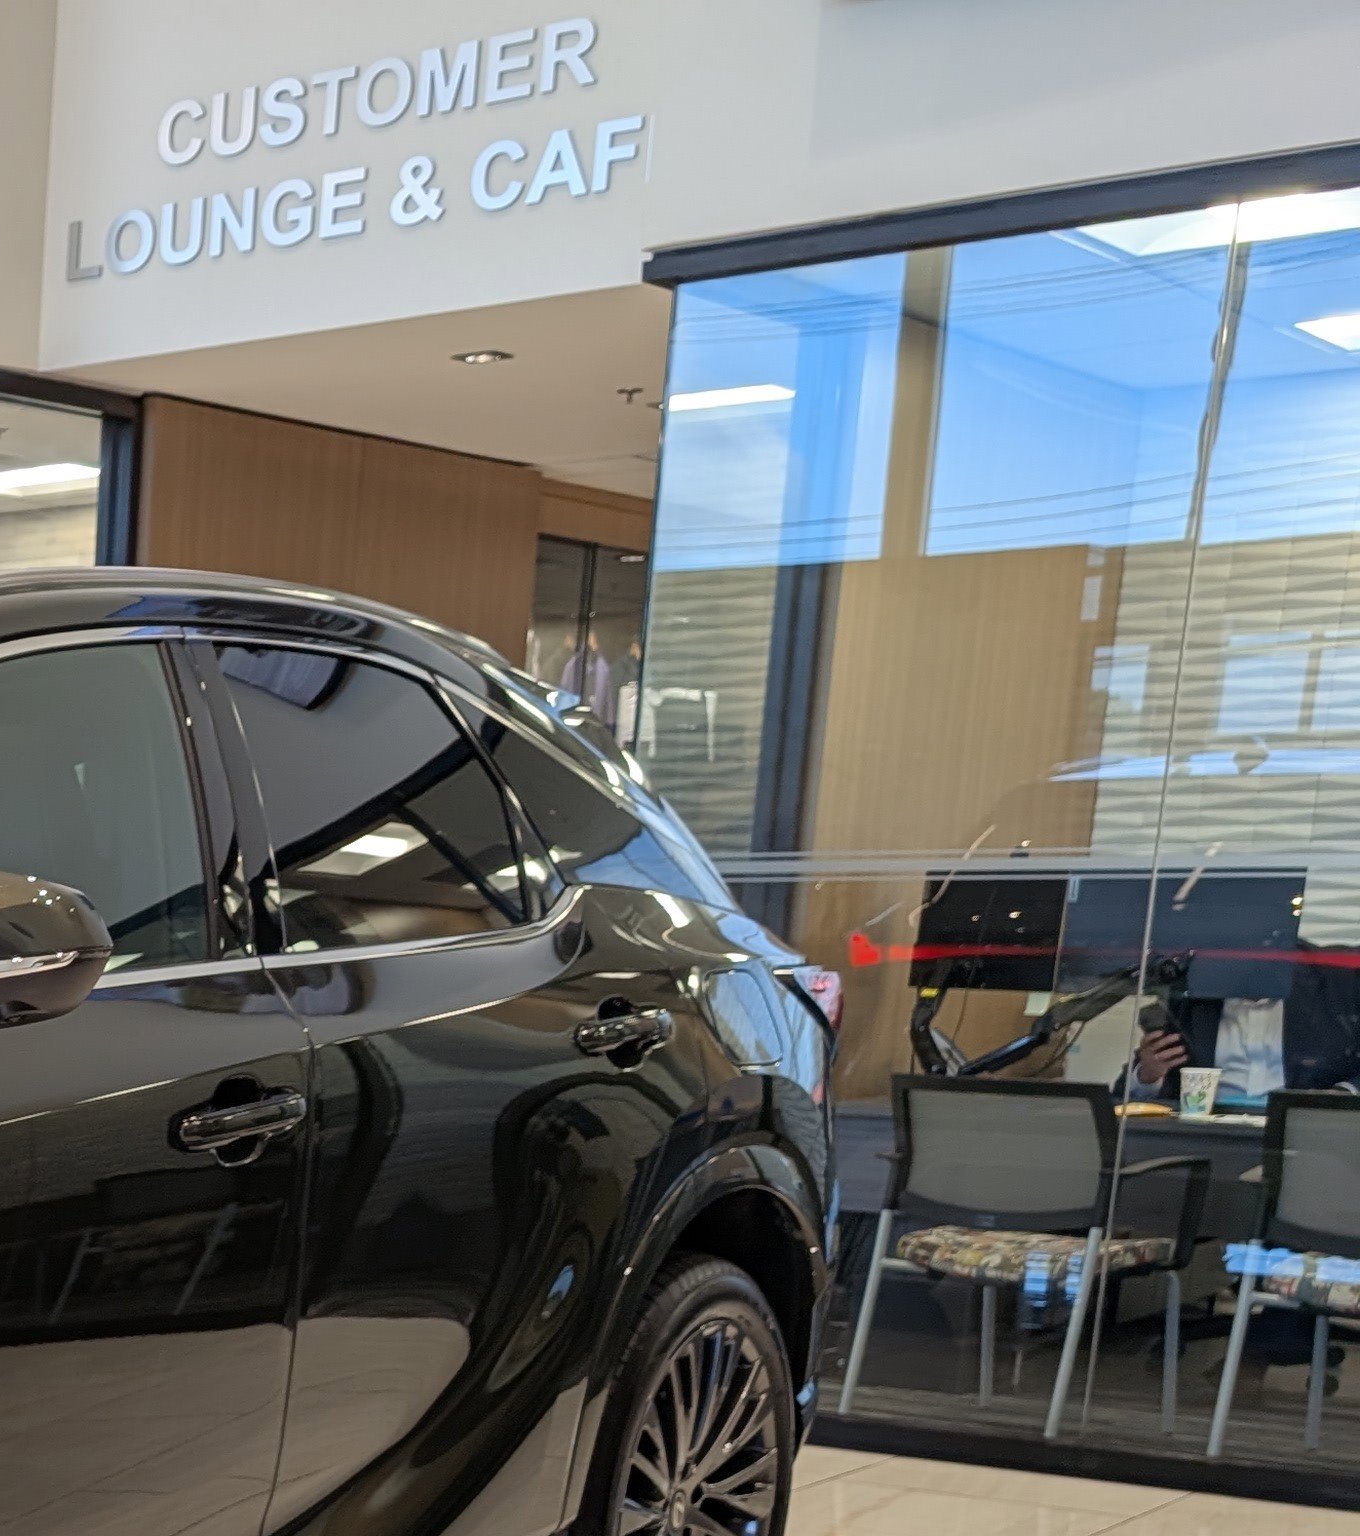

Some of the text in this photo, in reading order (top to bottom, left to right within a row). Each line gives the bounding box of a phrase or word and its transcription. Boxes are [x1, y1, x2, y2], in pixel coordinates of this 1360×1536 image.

[157, 17, 598, 166] CUSTOMER
[66, 166, 369, 281] LOUNGE
[390, 155, 446, 227] &
